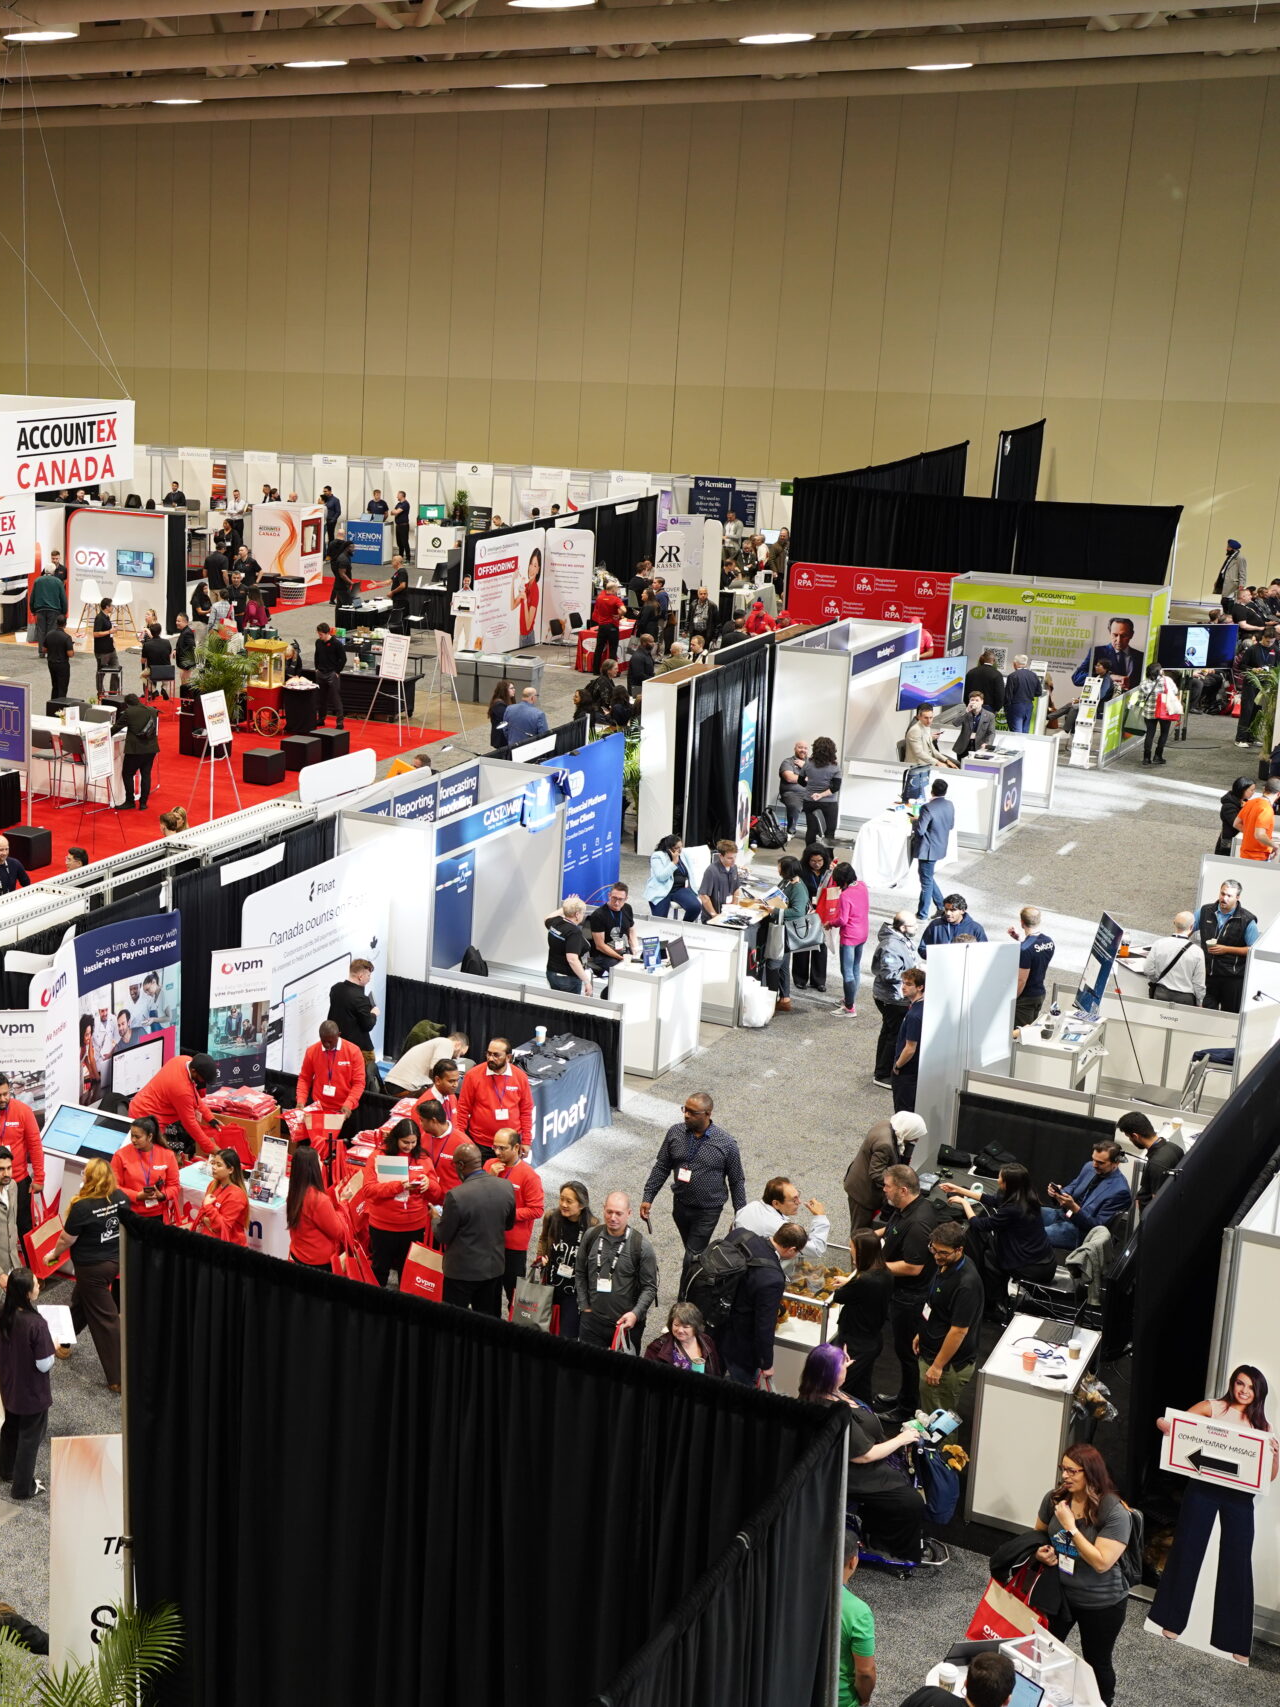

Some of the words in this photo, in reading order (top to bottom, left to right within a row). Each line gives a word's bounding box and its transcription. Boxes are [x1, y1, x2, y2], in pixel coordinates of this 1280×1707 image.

[17, 418, 117, 451] ACCOUNTEX
[17, 454, 115, 490] CANADA
[76, 550, 105, 567] OFX
[478, 561, 515, 576] OFFSHORING
[797, 579, 812, 587] RPA
[918, 588, 933, 596] RPA
[1036, 592, 1076, 601] ACCOUNTING
[825, 606, 840, 614] RPA
[885, 611, 900, 619] RPA
[973, 609, 983, 617] #1
[992, 614, 1026, 623] ACQUISITIONS
[1034, 615, 1053, 625] TIME
[1056, 617, 1077, 627] HAVE
[1033, 625, 1049, 635] YOU
[1051, 627, 1091, 638] INVESTED
[1032, 636, 1040, 644] IN
[1044, 637, 1064, 647] YOUR
[1067, 638, 1085, 649] EXIT
[1031, 646, 1076, 658] STRATEGY?
[396, 794, 434, 817] Reporting,
[439, 776, 476, 800] forecasting
[1004, 787, 1017, 812] GO
[439, 795, 473, 817] modelling
[317, 879, 335, 895] Float
[270, 921, 304, 945] Canada
[306, 909, 334, 931] counts
[96, 948, 111, 957] Save
[113, 942, 128, 952] time
[138, 933, 164, 945] money
[166, 928, 177, 939] with
[1034, 941, 1054, 953] Swoop
[83, 956, 120, 975] Hassle-Free
[122, 947, 147, 960] Payroll
[150, 939, 177, 954] Services
[235, 959, 263, 973] vpm
[51, 971, 67, 998] vpm
[1160, 1014, 1178, 1022] Swoop
[0, 1023, 34, 1036] vpm
[543, 1094, 587, 1144] Float
[421, 1279, 435, 1288] vpm
[1207, 1426, 1229, 1434] ACCOUNTEX
[1208, 1430, 1227, 1438] CANADA
[1178, 1433, 1227, 1449] COMPLIMENTARY
[1229, 1446, 1256, 1457] MASSAGE
